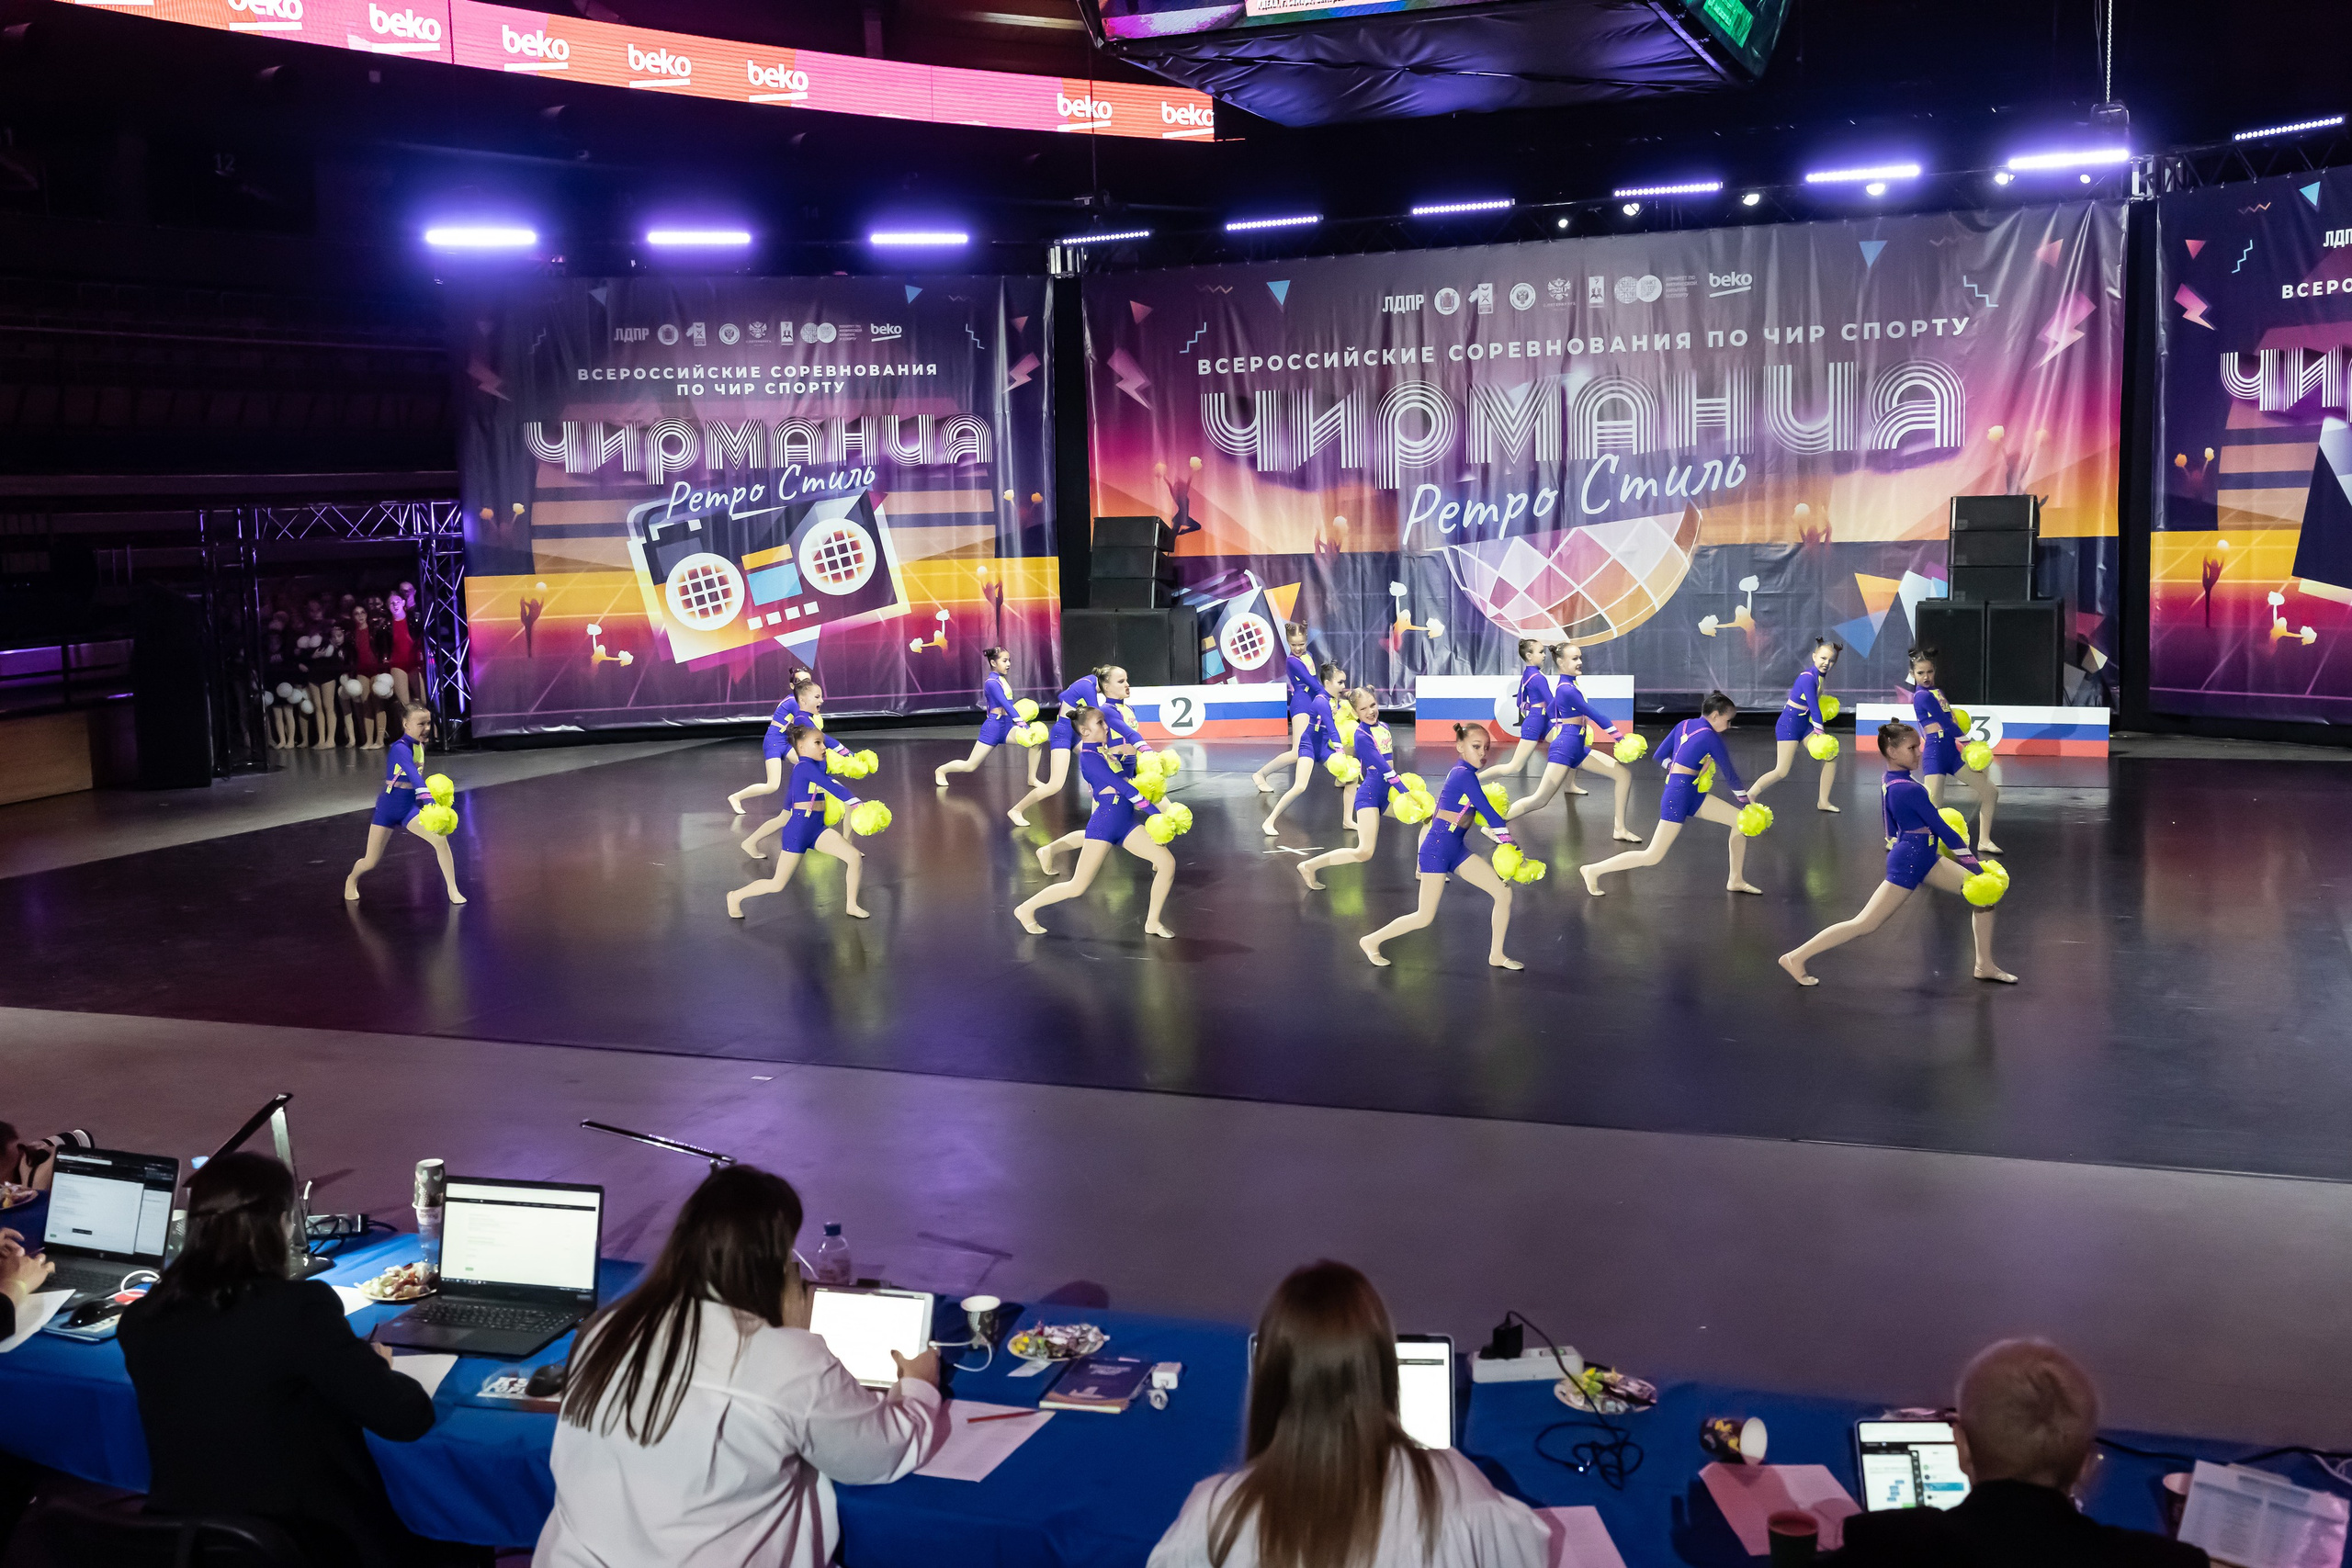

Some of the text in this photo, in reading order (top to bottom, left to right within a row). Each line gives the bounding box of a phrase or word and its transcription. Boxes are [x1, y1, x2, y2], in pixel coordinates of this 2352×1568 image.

[369, 4, 441, 41] beko
[503, 25, 569, 60] beko
[628, 44, 691, 76] beko
[748, 61, 808, 91] beko
[1057, 93, 1112, 118] beko
[1162, 102, 1214, 127] beko
[213, 152, 236, 172] 12
[1708, 271, 1753, 288] beko
[1382, 294, 1425, 314] ЛДПР
[614, 327, 650, 344] ЛДПР
[870, 322, 902, 335] beko
[1197, 316, 1970, 376] ВСЕРОССИЙСКИЕ СОРЕВНОВАНИЯ ПО ЧИР СПОРТУ
[578, 364, 937, 380] ВСЕРОССИЙСКИЕ СОРЕВНОВАНИЯ
[676, 381, 845, 396] ПО ЧИР СПОРТУ
[666, 463, 876, 520] Ретро Стиль
[1402, 453, 1747, 546] Ретро Стиль
[1171, 697, 1193, 728] 2
[1971, 716, 1991, 741] 3
